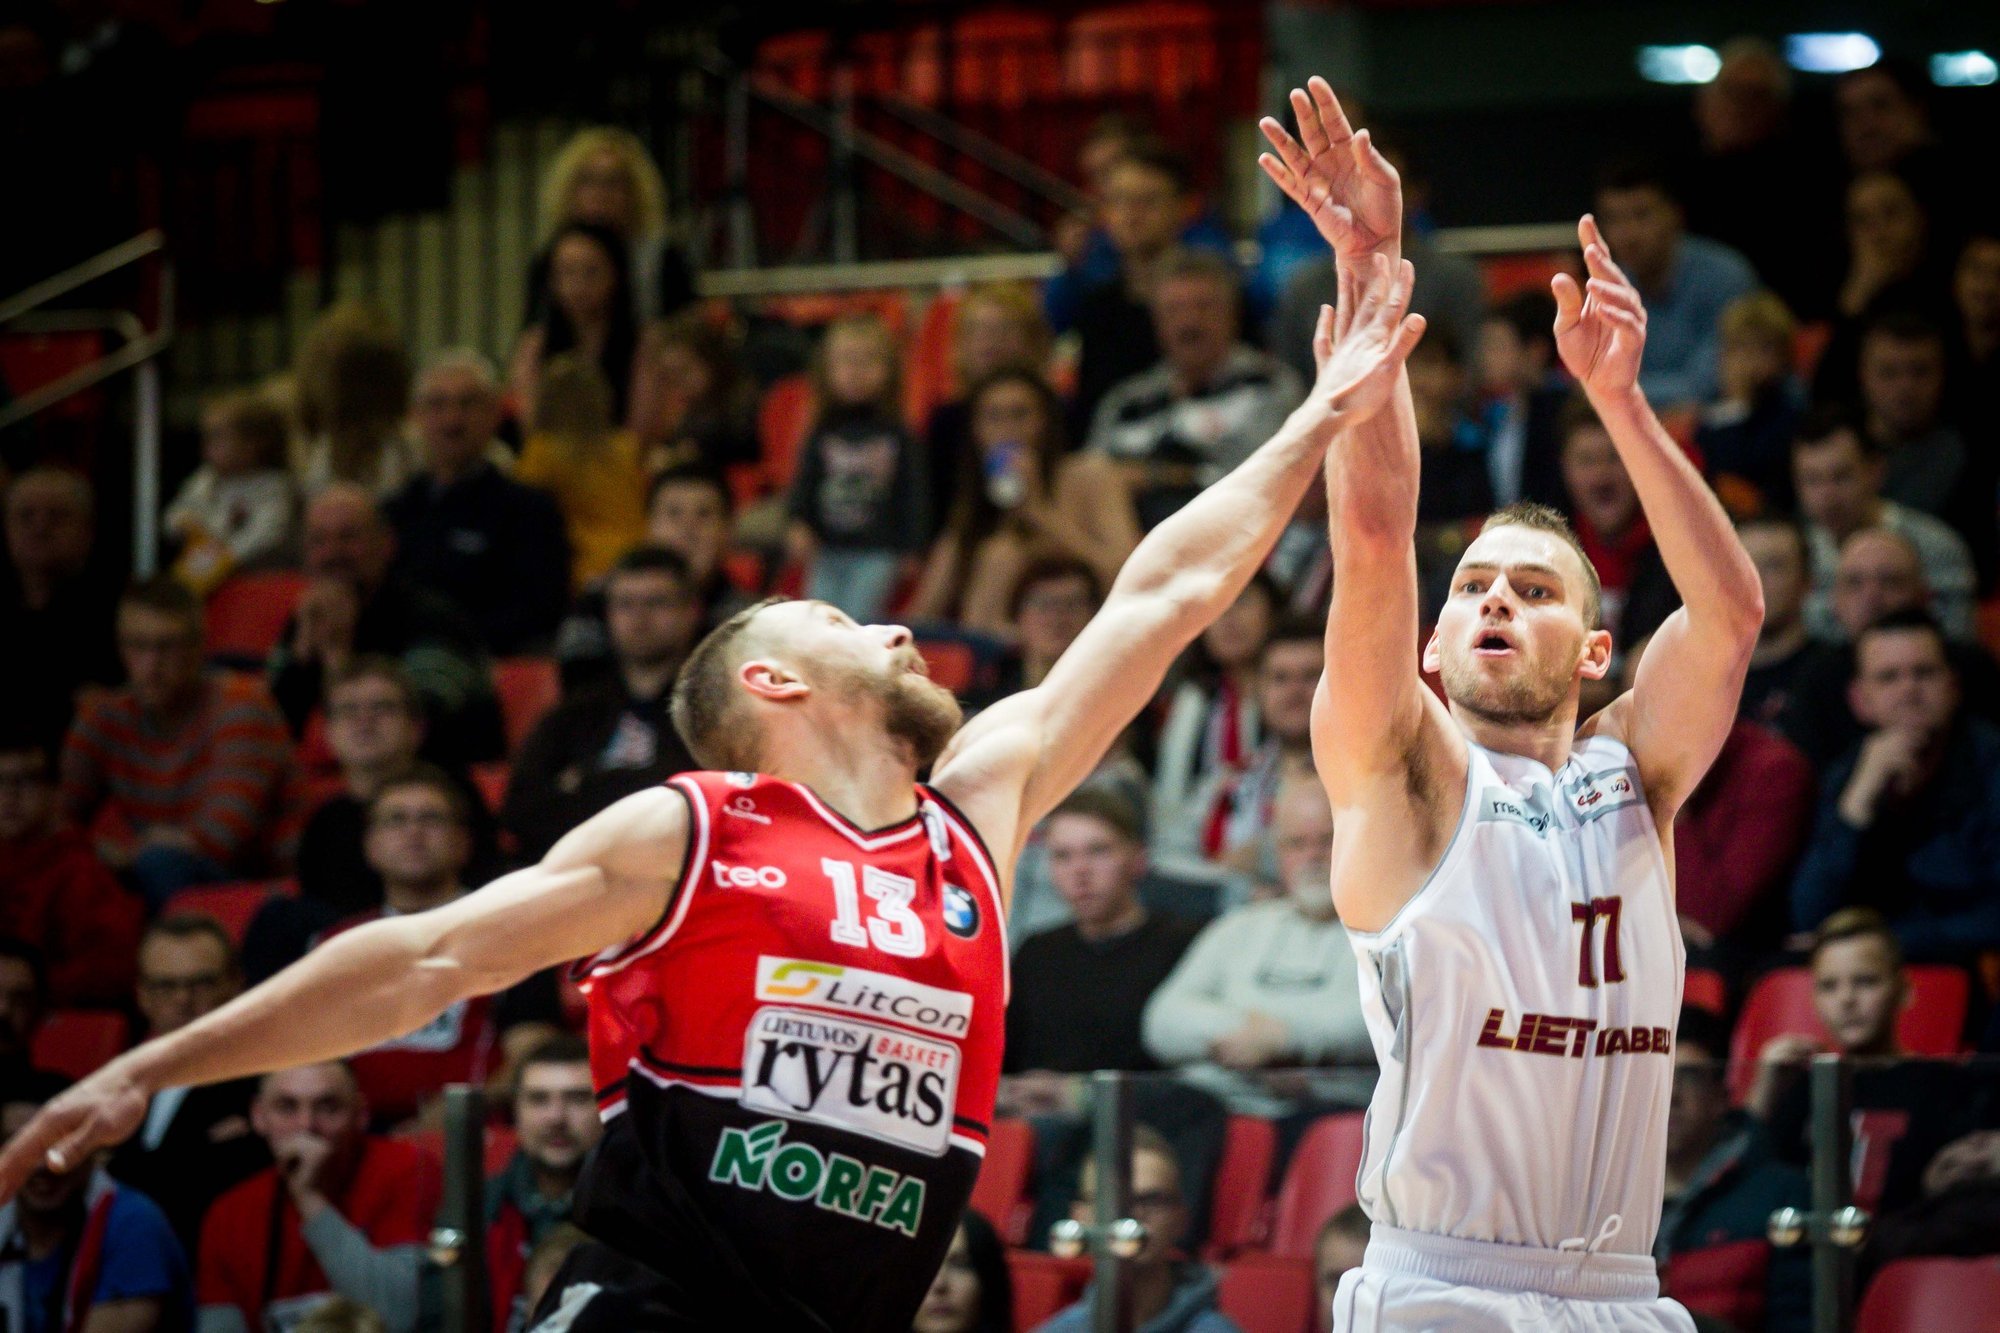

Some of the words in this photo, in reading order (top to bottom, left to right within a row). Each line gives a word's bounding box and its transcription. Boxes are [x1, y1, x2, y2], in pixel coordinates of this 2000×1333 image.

[712, 859, 787, 889] teo
[821, 857, 926, 959] 13
[1571, 895, 1627, 990] 77
[762, 1016, 860, 1048] LIETUVOS
[824, 981, 968, 1032] LitCon
[752, 1033, 947, 1127] rytas
[876, 1037, 951, 1070] BASKET
[708, 1120, 927, 1239] NORFA
